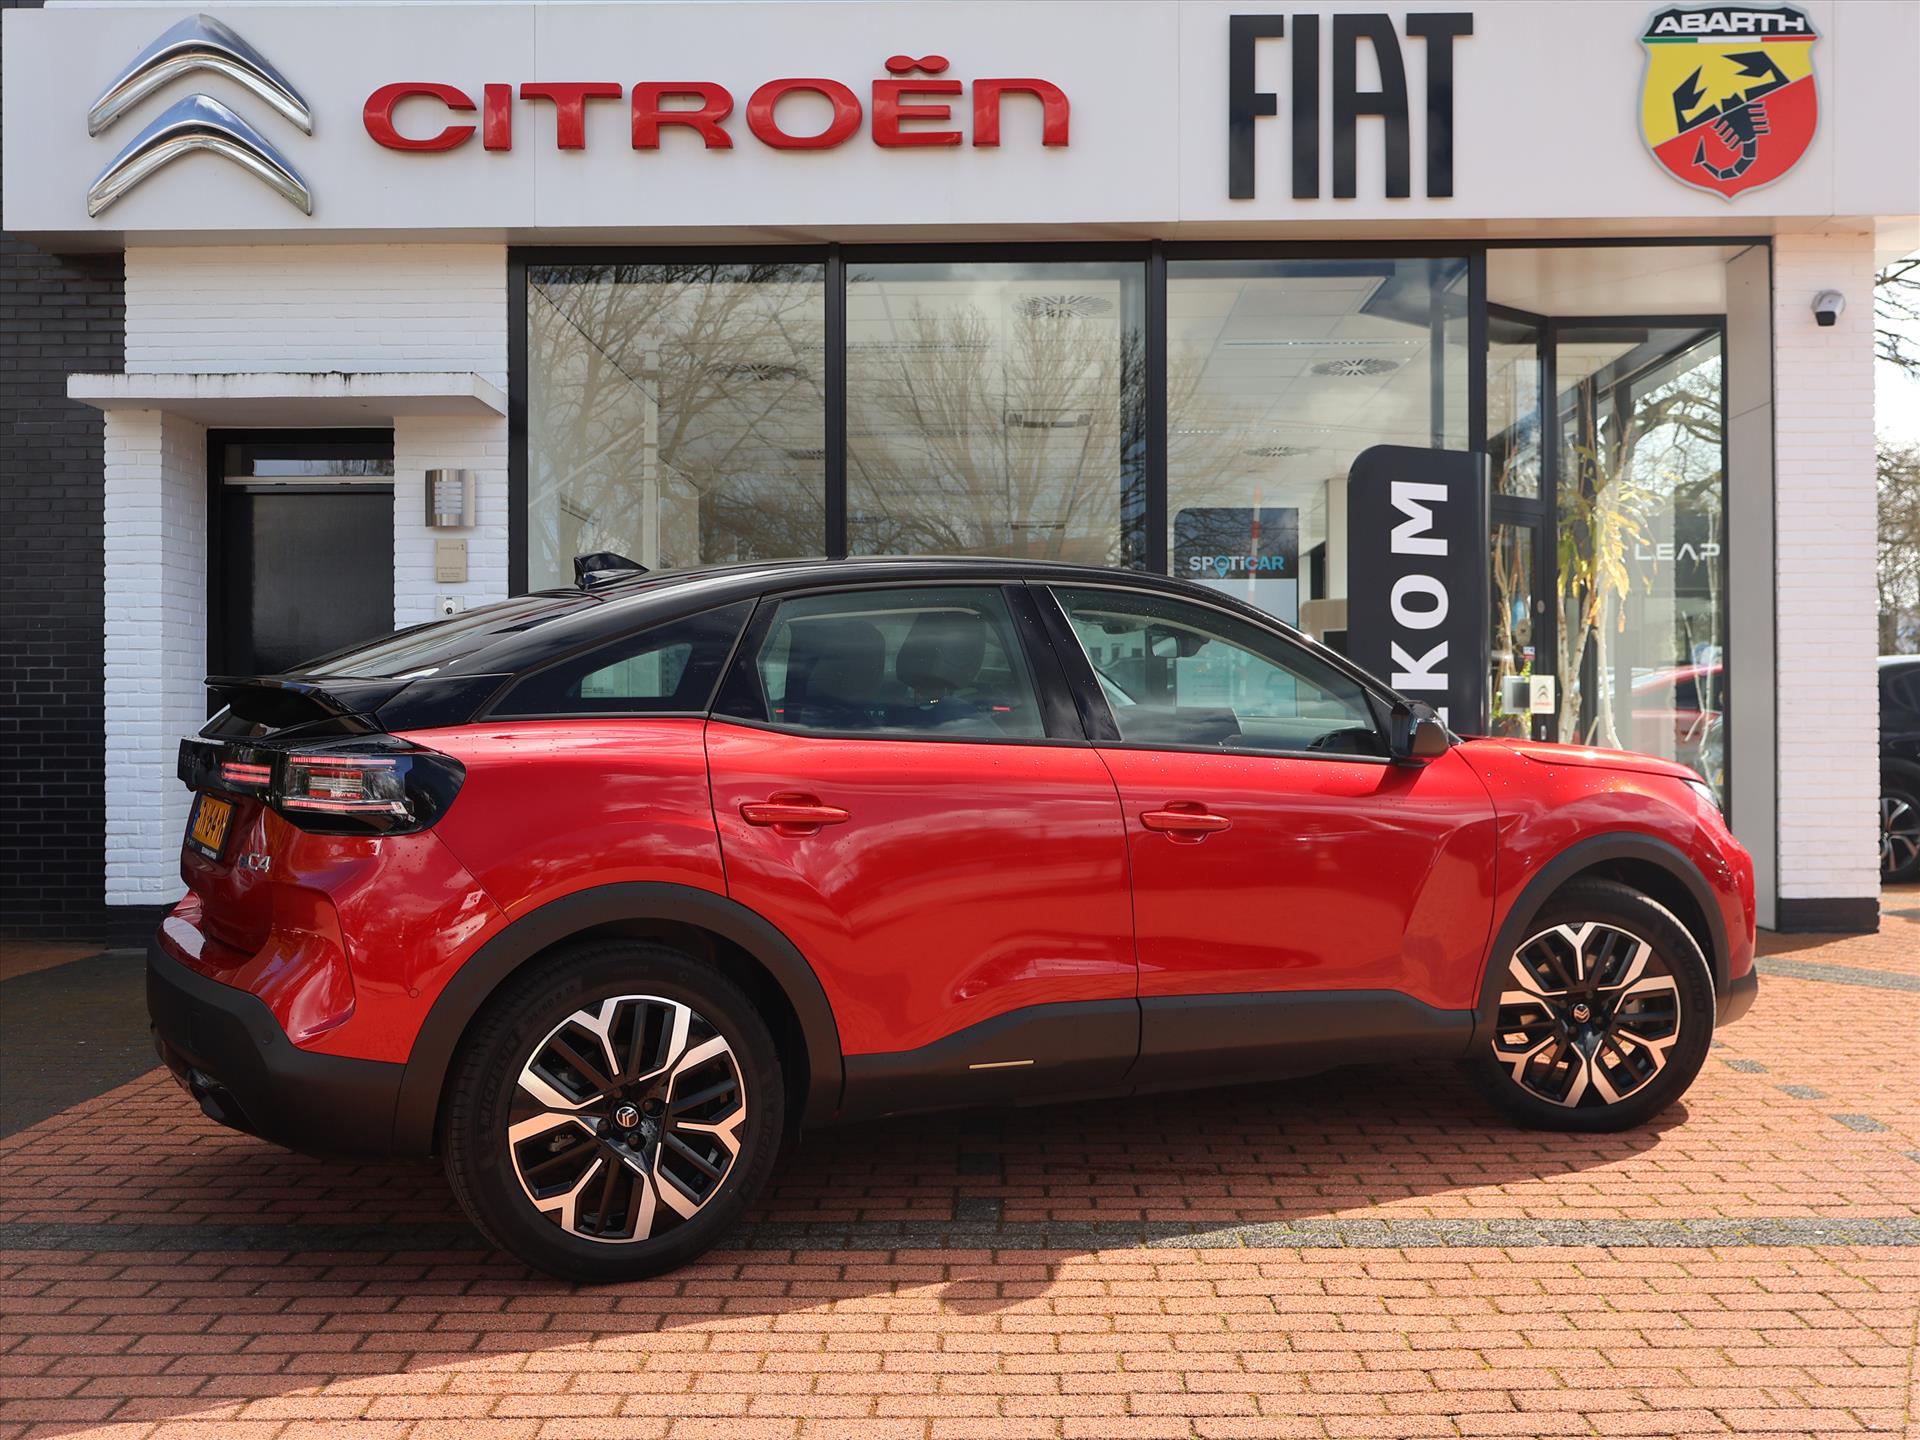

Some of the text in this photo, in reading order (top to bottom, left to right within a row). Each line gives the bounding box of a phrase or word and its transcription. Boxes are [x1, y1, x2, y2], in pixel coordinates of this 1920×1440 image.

[1654, 12, 1804, 33] ABARTH
[362, 55, 1070, 151] CITROËN
[1229, 12, 1473, 199] FIAT
[1635, 543, 1720, 560] LEAP
[1391, 481, 1448, 727] KOM
